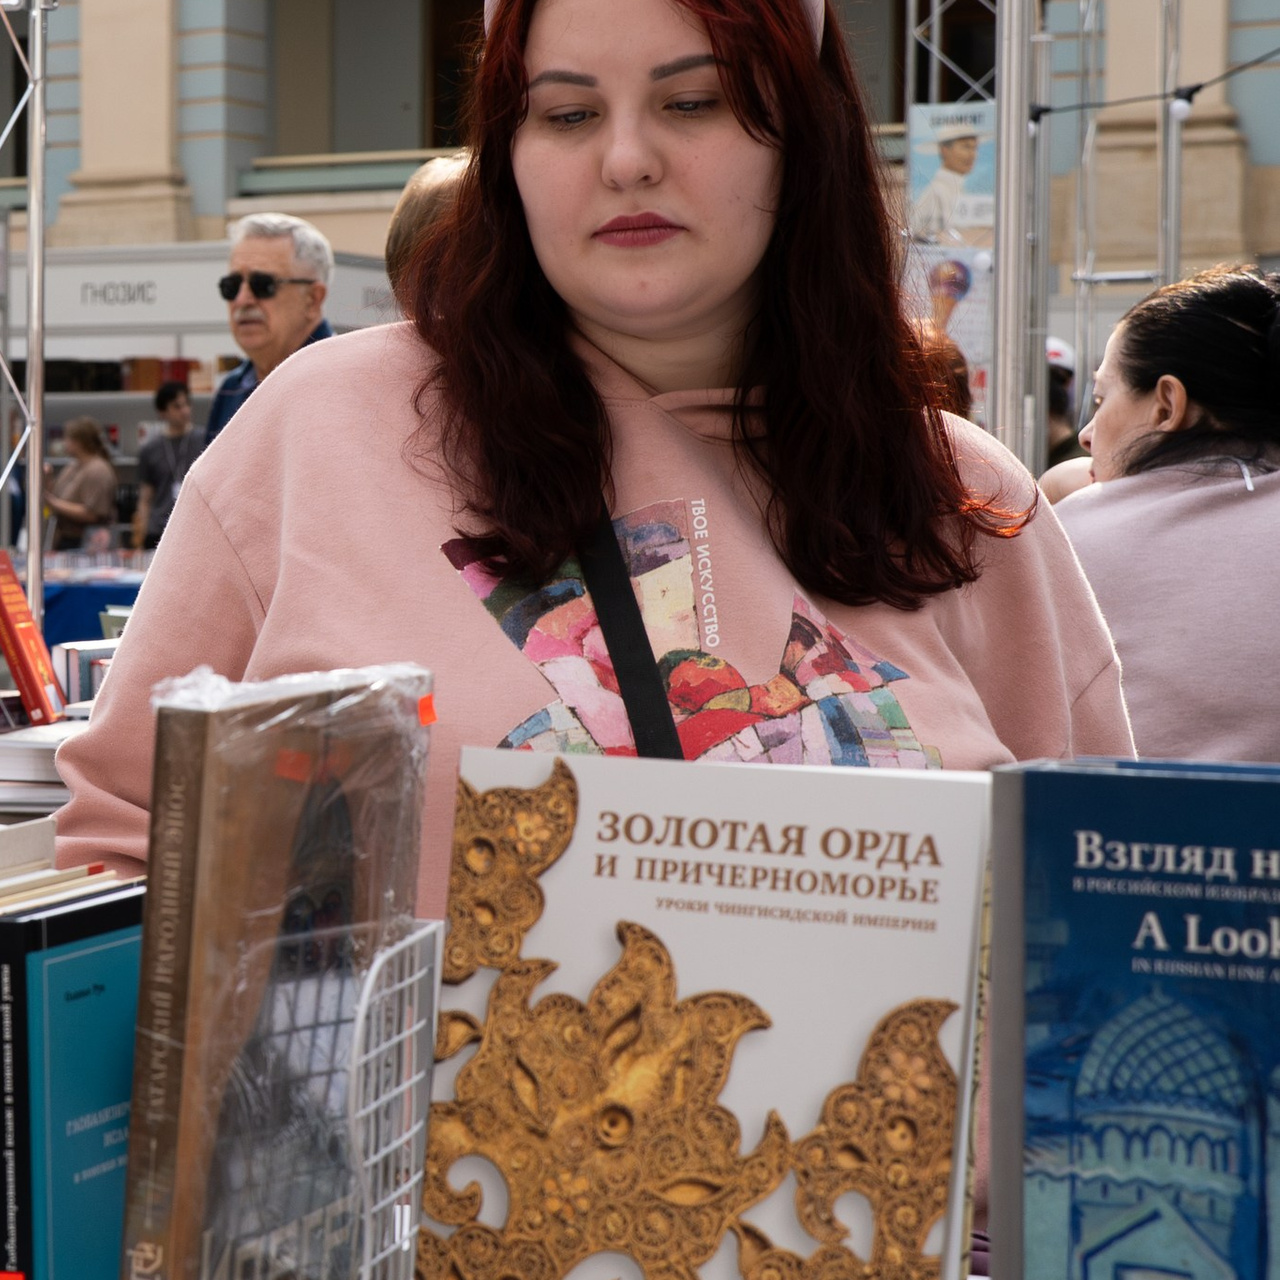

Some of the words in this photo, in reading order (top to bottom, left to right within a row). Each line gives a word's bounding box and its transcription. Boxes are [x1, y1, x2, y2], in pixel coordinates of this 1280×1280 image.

[691, 498, 710, 541] ТВОЕ
[694, 544, 721, 648] ИСКУССТВО
[596, 810, 808, 858] ЗОЛОТАЯ
[820, 826, 942, 870] ОРДА
[1073, 829, 1238, 883] Взгляд
[1250, 848, 1280, 880] н
[594, 853, 618, 879] И
[634, 856, 940, 905] ПРИЧЕРНОМОРЬЕ
[655, 896, 710, 914] УРОКИ
[852, 913, 938, 933] ИМПЕРИИ
[1131, 911, 1169, 950] A
